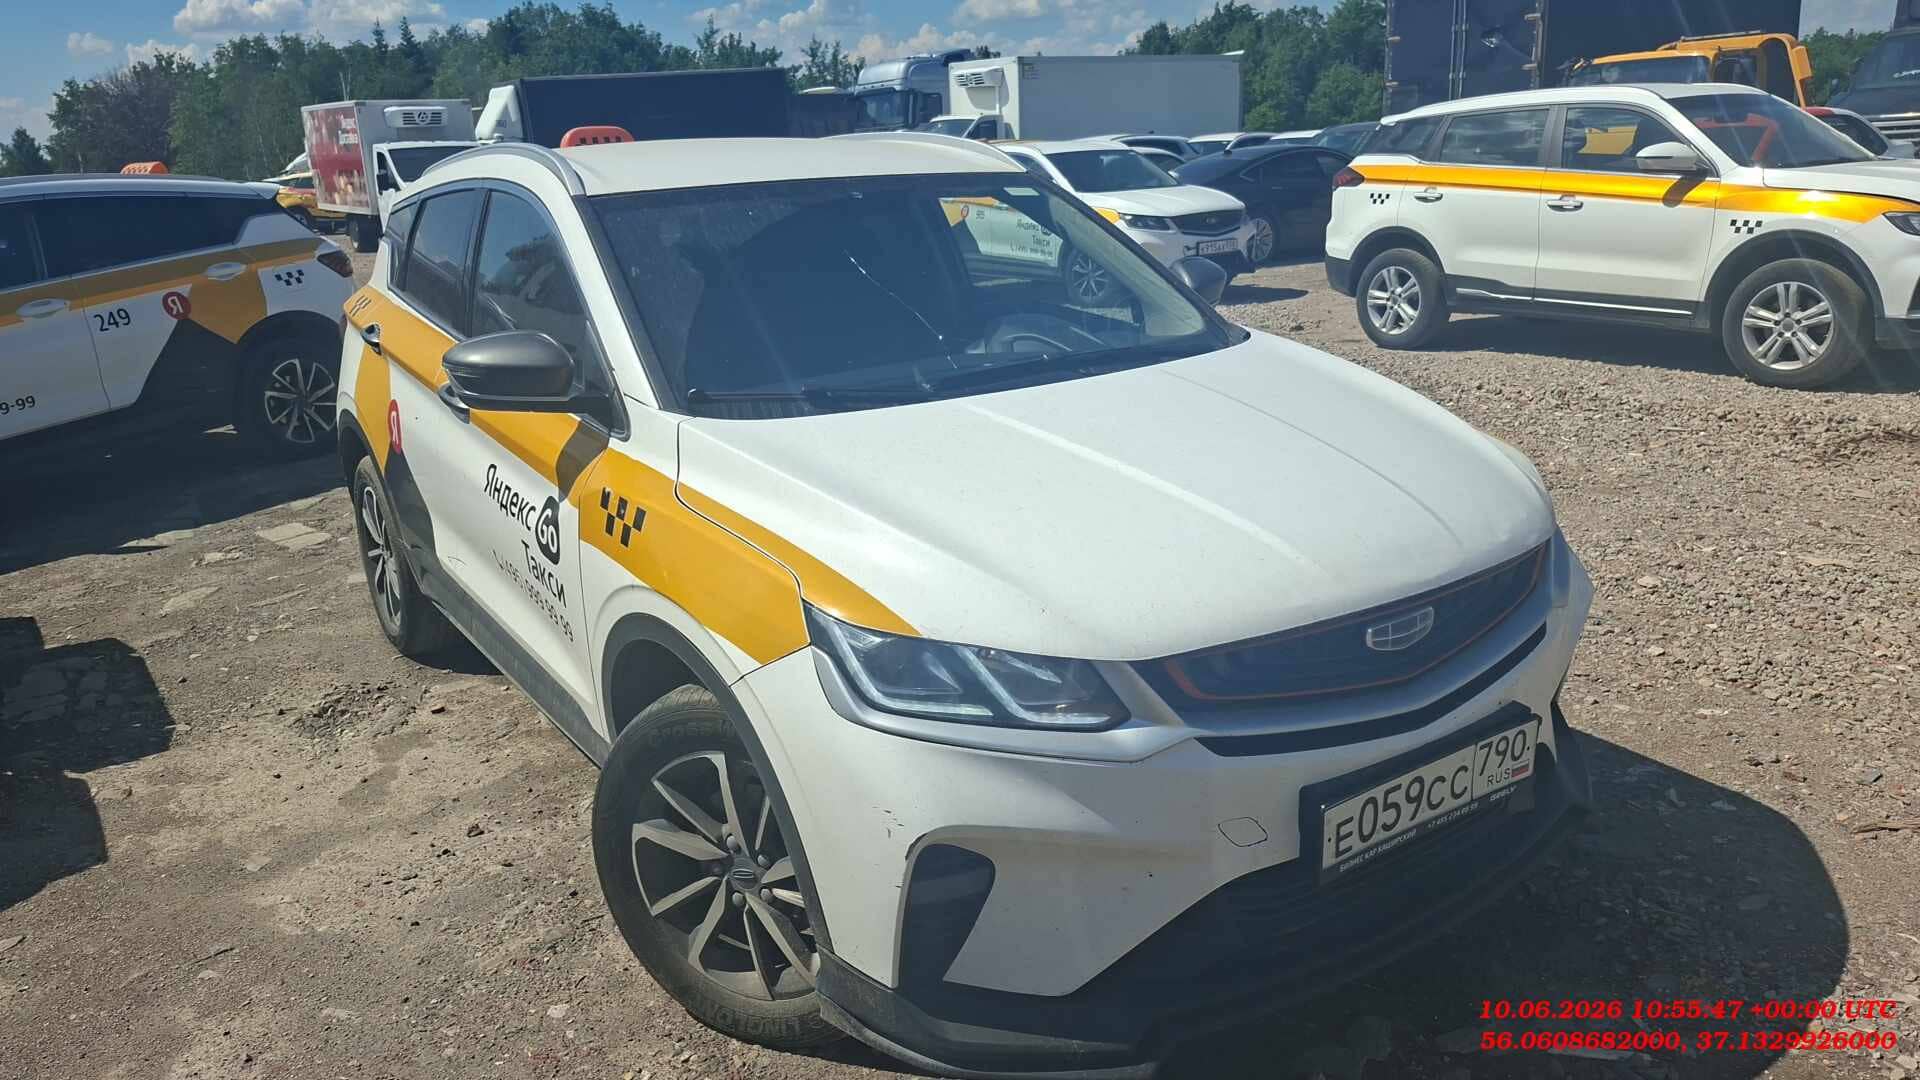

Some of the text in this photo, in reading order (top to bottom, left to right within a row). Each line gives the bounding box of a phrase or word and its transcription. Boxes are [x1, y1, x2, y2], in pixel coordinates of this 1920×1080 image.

[93, 307, 132, 332] 249
[167, 295, 184, 315] Я
[390, 410, 399, 445] Я
[484, 463, 558, 554] Яндекс Go
[521, 539, 567, 608] Такси
[1479, 729, 1527, 777] 790
[1487, 767, 1511, 786] RUS
